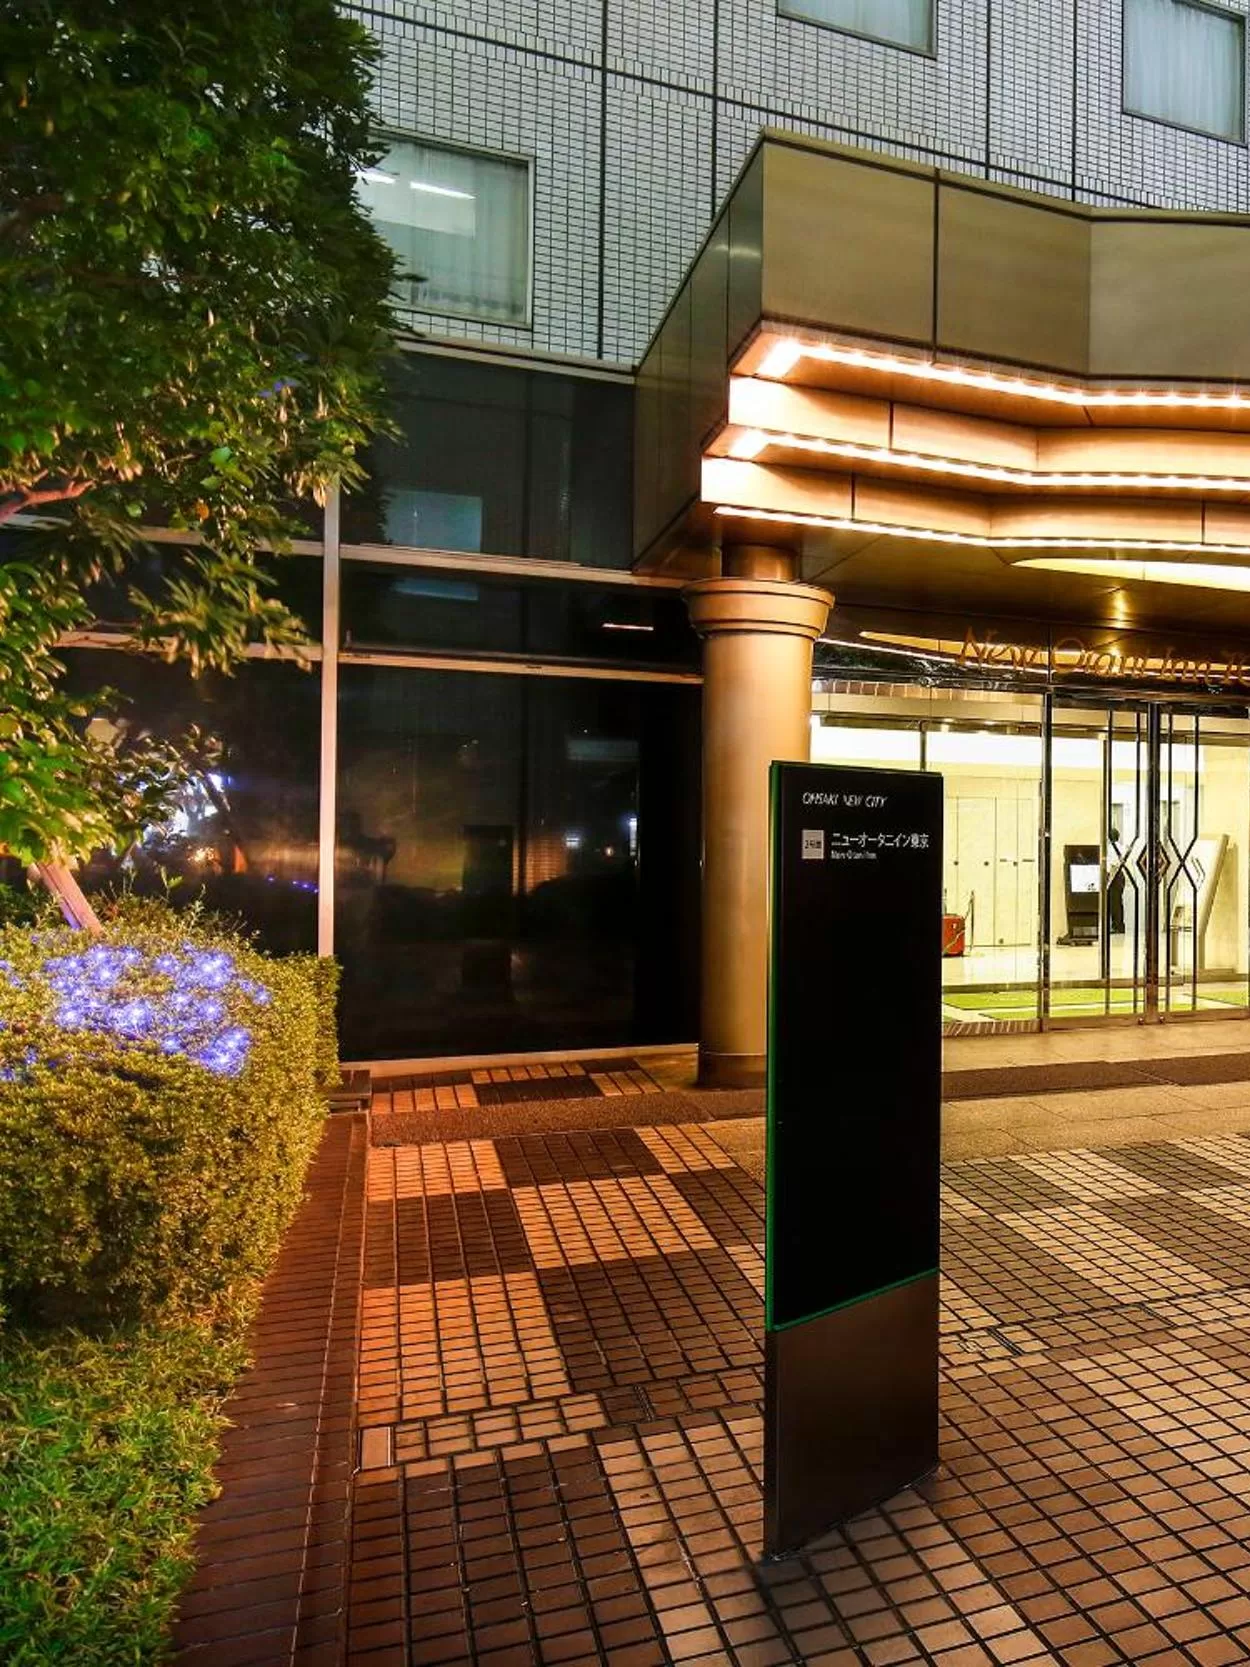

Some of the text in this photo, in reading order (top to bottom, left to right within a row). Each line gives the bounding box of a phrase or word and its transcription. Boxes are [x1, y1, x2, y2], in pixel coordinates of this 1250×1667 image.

[959, 626, 1043, 672] New
[1051, 637, 1148, 680] Otani
[843, 795, 863, 807] NEW
[865, 796, 888, 808] CITY
[831, 833, 929, 848] ニューオータニイン東京
